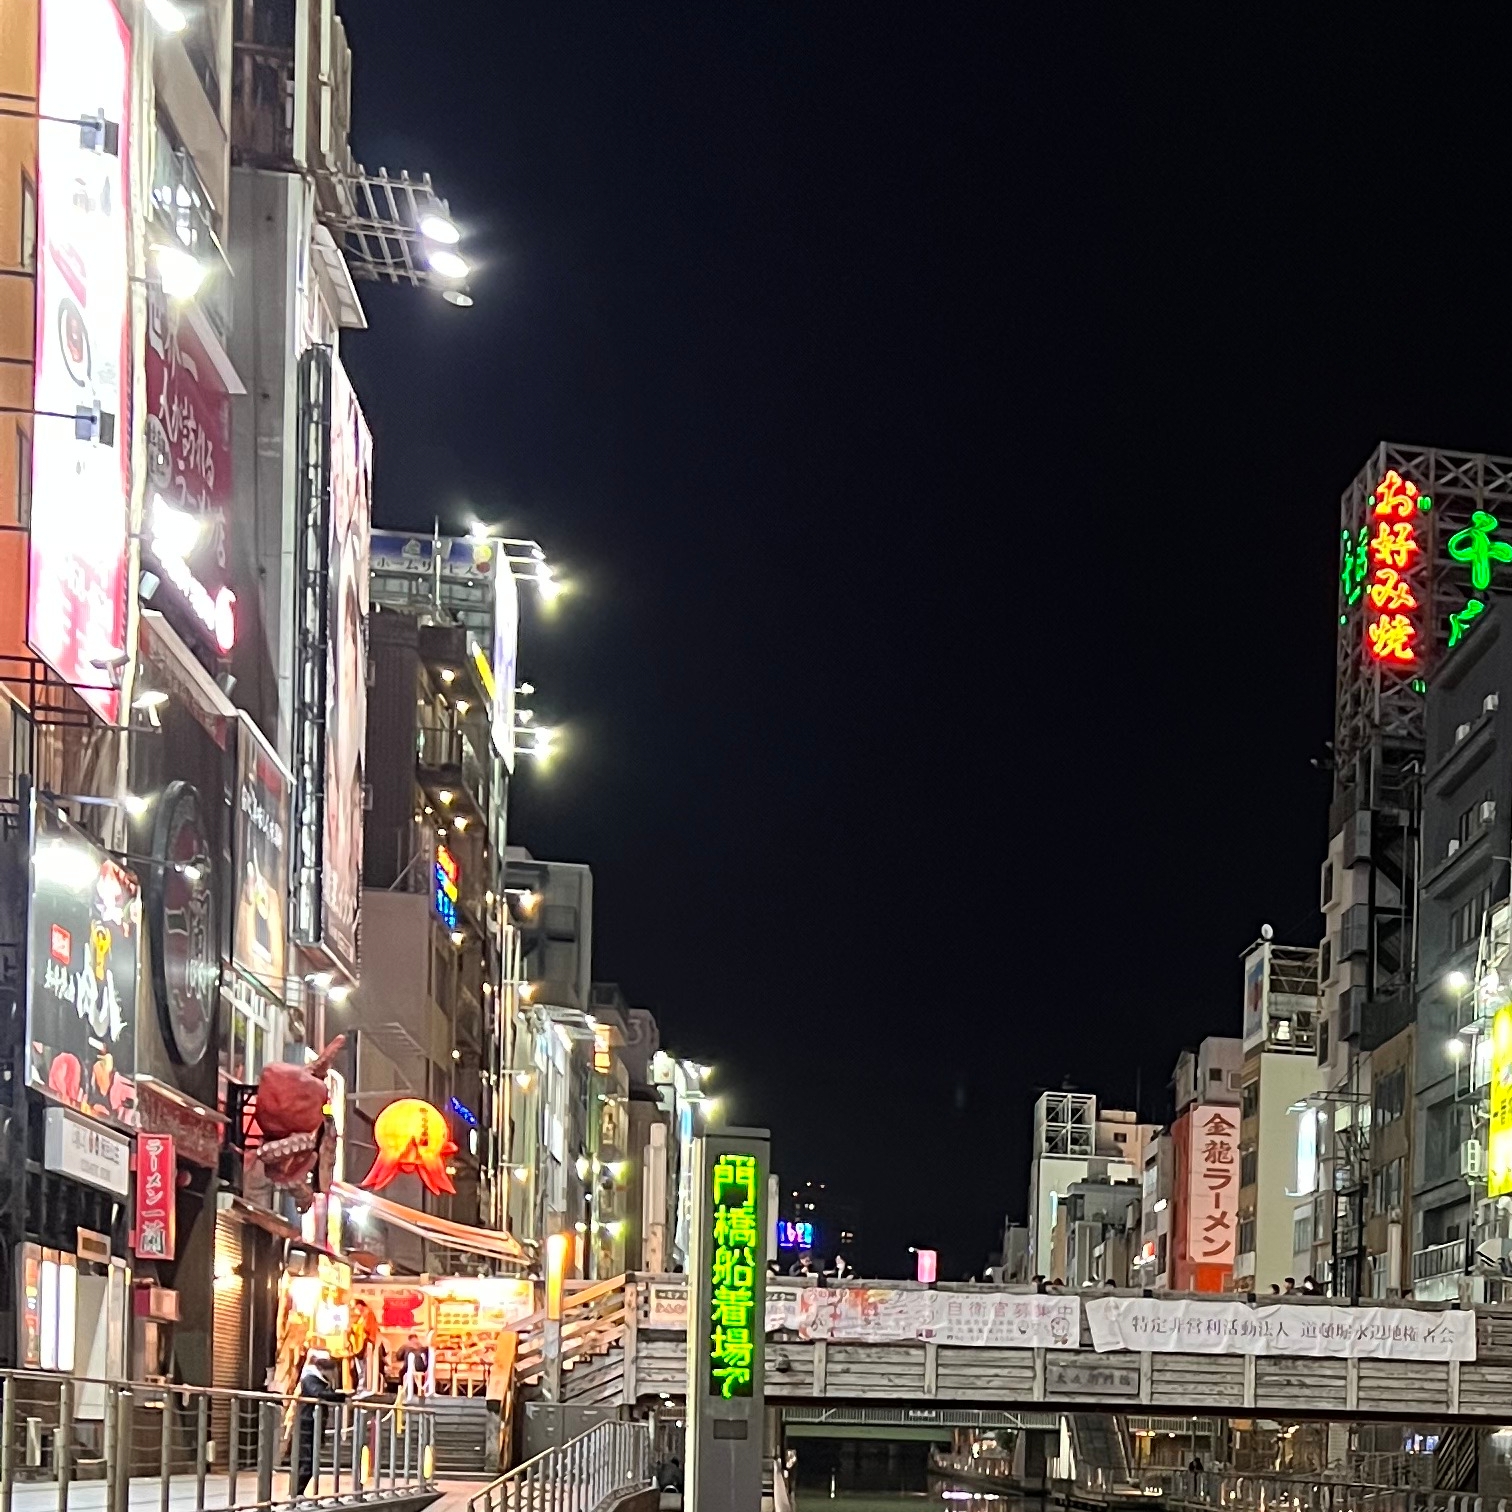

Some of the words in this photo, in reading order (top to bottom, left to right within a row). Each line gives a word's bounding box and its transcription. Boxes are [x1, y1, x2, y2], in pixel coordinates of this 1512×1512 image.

[1368, 468, 1418, 661] お好み焼
[141, 1138, 166, 1258] ラーメン一蘭
[1202, 1112, 1236, 1258] 金龍ラーメン
[1131, 1314, 1290, 1340] 特定非営利活動法人
